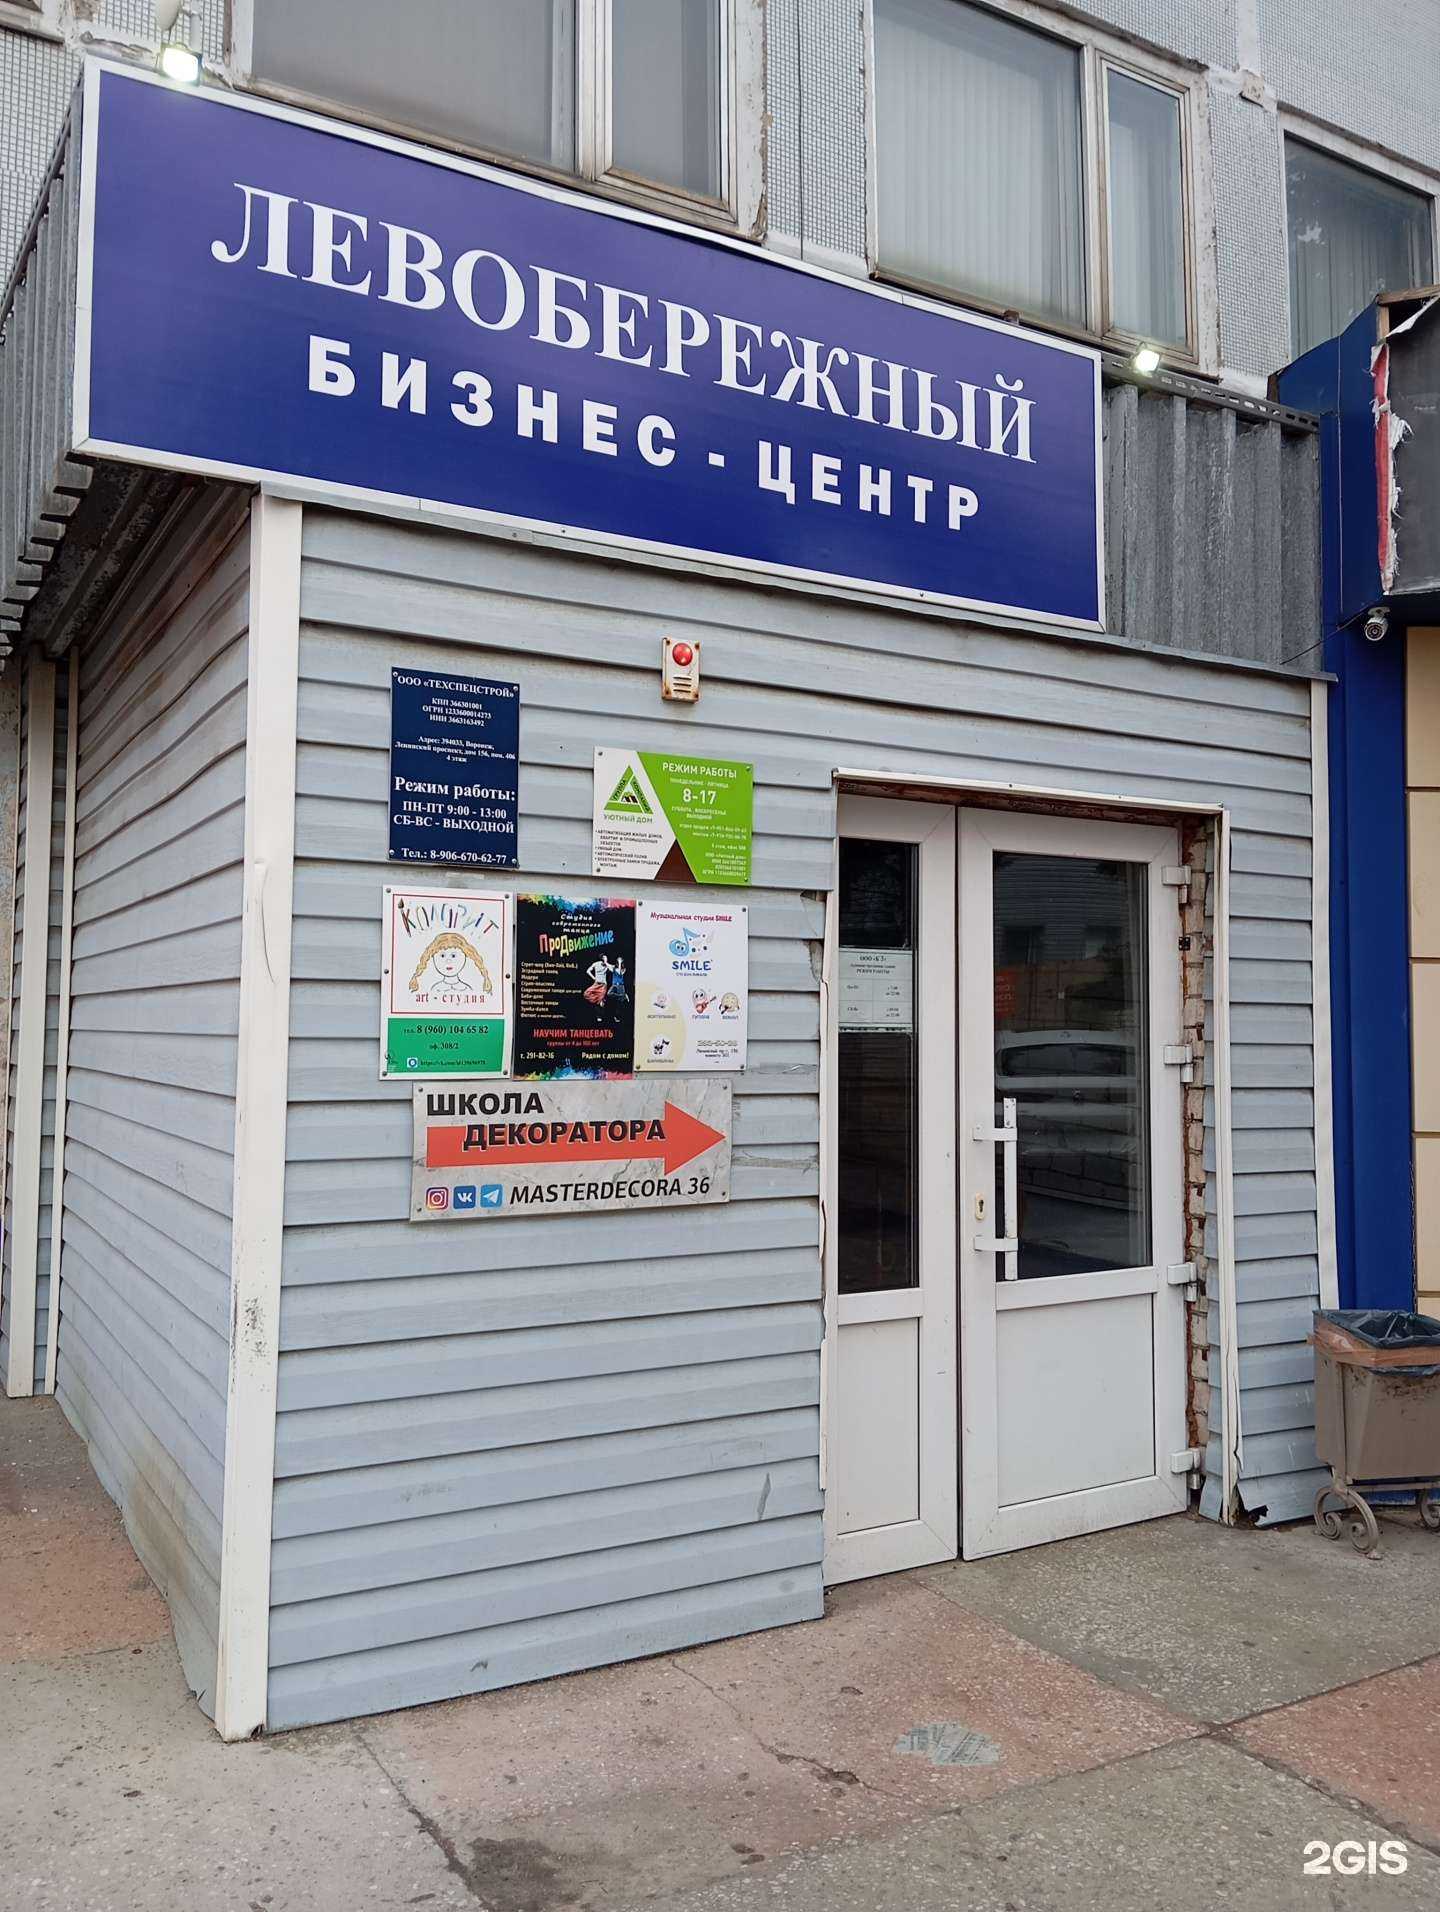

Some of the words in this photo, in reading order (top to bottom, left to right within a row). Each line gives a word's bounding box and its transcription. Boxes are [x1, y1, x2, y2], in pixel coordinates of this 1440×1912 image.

[211, 183, 1036, 464] ЛЕВОБЕРЕЖНЫЙ
[308, 335, 676, 467] БИЗНЕС
[758, 441, 979, 531] ЦЕНТР
[398, 676, 421, 686] ООО
[424, 679, 514, 698] «ТЕХСПЕЦСТРОЙ»
[422, 705, 443, 714] ОГРН
[432, 697, 449, 706] КПП
[430, 714, 447, 722] ИНН
[662, 762, 698, 775] РЕЖИМ
[700, 766, 737, 779] РАБОТЫ
[395, 776, 449, 795] Режим
[454, 784, 516, 801] работы:
[683, 788, 716, 805] 8-17
[403, 801, 445, 814] ПН-ПТ
[447, 804, 470, 816] 9:00
[479, 807, 507, 819] 13:00
[393, 815, 433, 827] СБ-ВС
[443, 818, 514, 834] ВЫХОДНОЙ
[604, 814, 635, 822] УЮТНЫЙ
[636, 816, 653, 824] ДОМ
[401, 847, 428, 859] Тел.:
[430, 850, 507, 864] 8-906-670-62-77
[650, 912, 692, 920] Музыкальная
[539, 930, 614, 957] ПроДвижение
[672, 960, 711, 971] SMILE
[416, 993, 429, 1003] art
[416, 1025, 422, 1034] 8
[424, 1025, 446, 1035] (960)
[449, 1025, 464, 1034] 104
[466, 1025, 476, 1034] 65
[478, 1025, 489, 1034] 82
[534, 1029, 567, 1038] НАУЧИМ
[570, 1029, 613, 1038] ТАНЦЕВАТЬ
[581, 1051, 601, 1059] Рядом
[427, 1093, 544, 1116] ШКОЛА
[463, 1119, 666, 1151] ДЕКОРАТОРА
[510, 1177, 681, 1204] MASTERDECORA
[687, 1177, 711, 1195] 36
